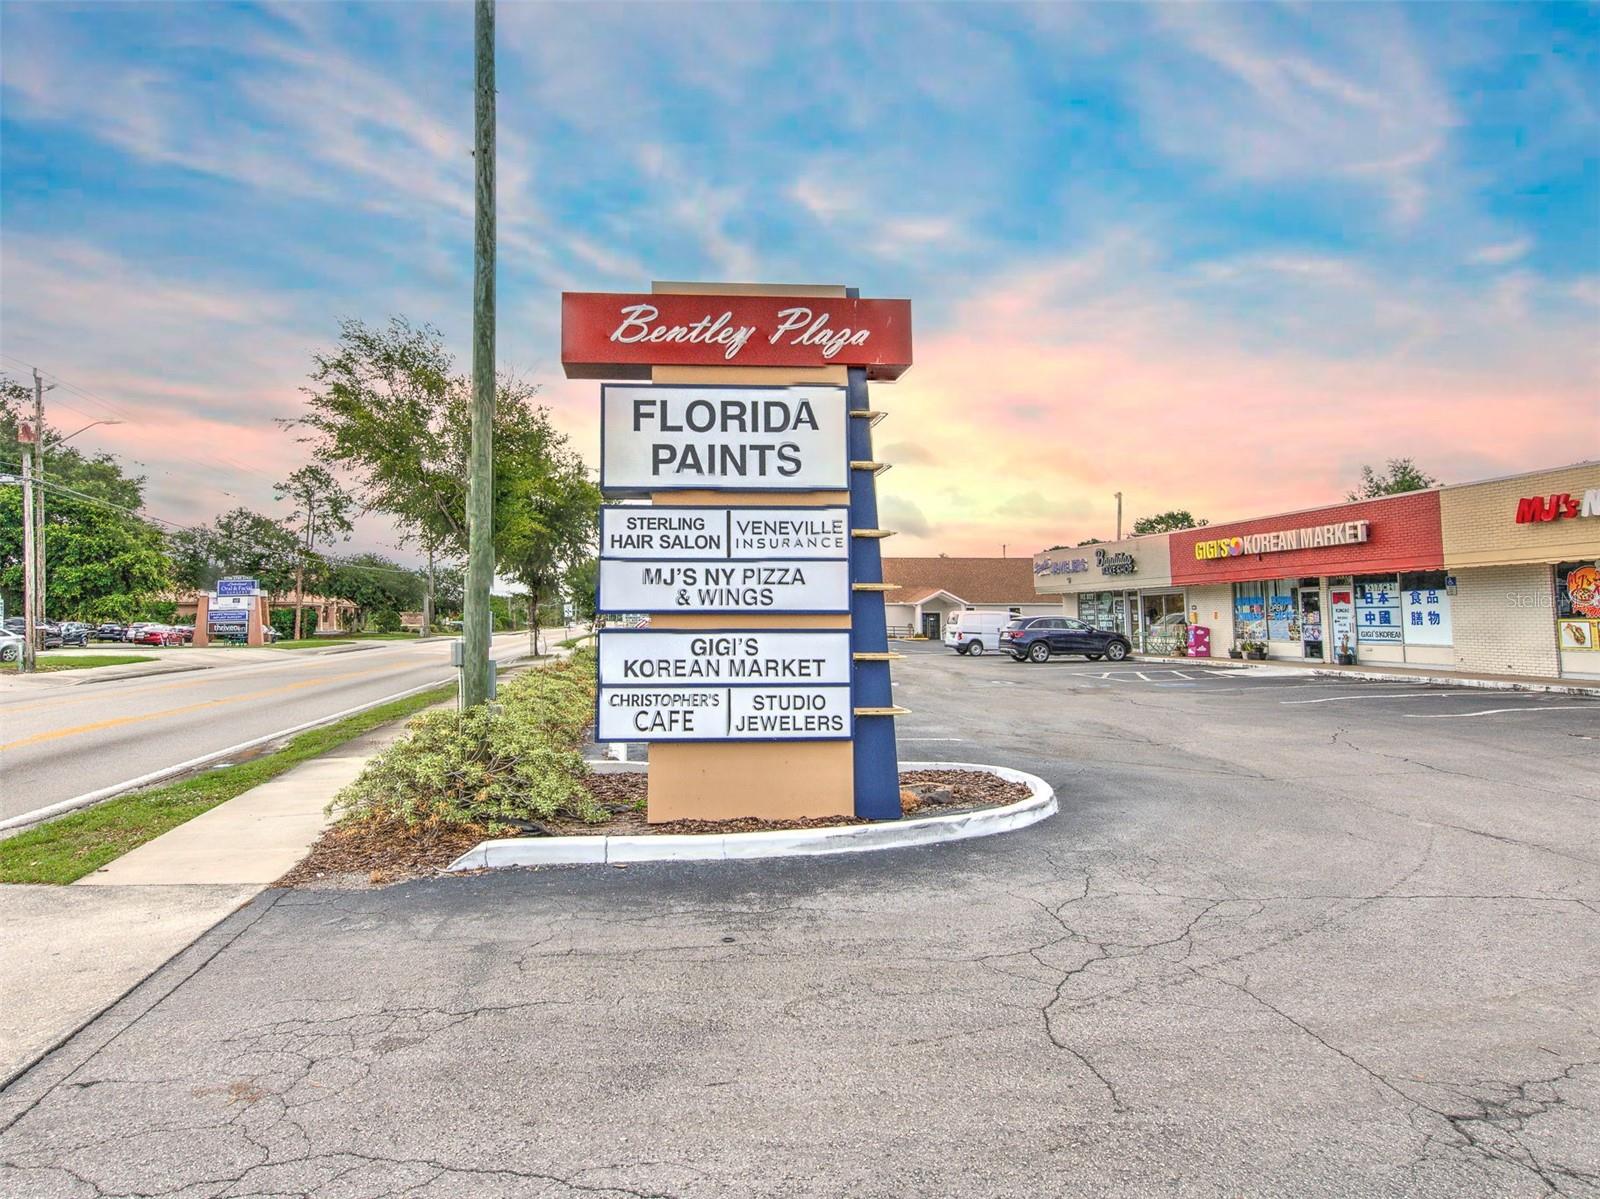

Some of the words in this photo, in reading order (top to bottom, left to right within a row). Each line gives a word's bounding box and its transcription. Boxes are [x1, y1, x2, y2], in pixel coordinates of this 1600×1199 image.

[610, 303, 756, 360] Bentley
[769, 307, 871, 359] Plaza
[632, 398, 820, 433] FLORIDA
[652, 442, 803, 478] PAINTS
[1515, 493, 1580, 524] MJ's
[626, 517, 706, 531] STERLING
[736, 520, 843, 535] VENEVILLE
[610, 534, 654, 550] HAIR
[659, 534, 721, 550] SALON
[735, 537, 844, 549] INSURANCE
[1195, 537, 1229, 560] GIGI'S
[1243, 530, 1299, 554] KOREAN
[1300, 520, 1370, 549] MARKET
[642, 568, 698, 586] MJ'S
[704, 568, 736, 586] NY
[742, 568, 806, 585] PIZZA
[676, 589, 691, 606] &
[698, 588, 774, 606] WINGS
[1410, 589, 1438, 605] 食品
[690, 638, 759, 656] GIGI'S
[624, 659, 720, 678] KOREAN
[728, 659, 826, 677] MARKET
[608, 693, 720, 707] CHRISTOPHER'S
[752, 695, 826, 711] STUDIO
[634, 710, 695, 732] CAFE
[736, 715, 844, 732] JEWELERS
